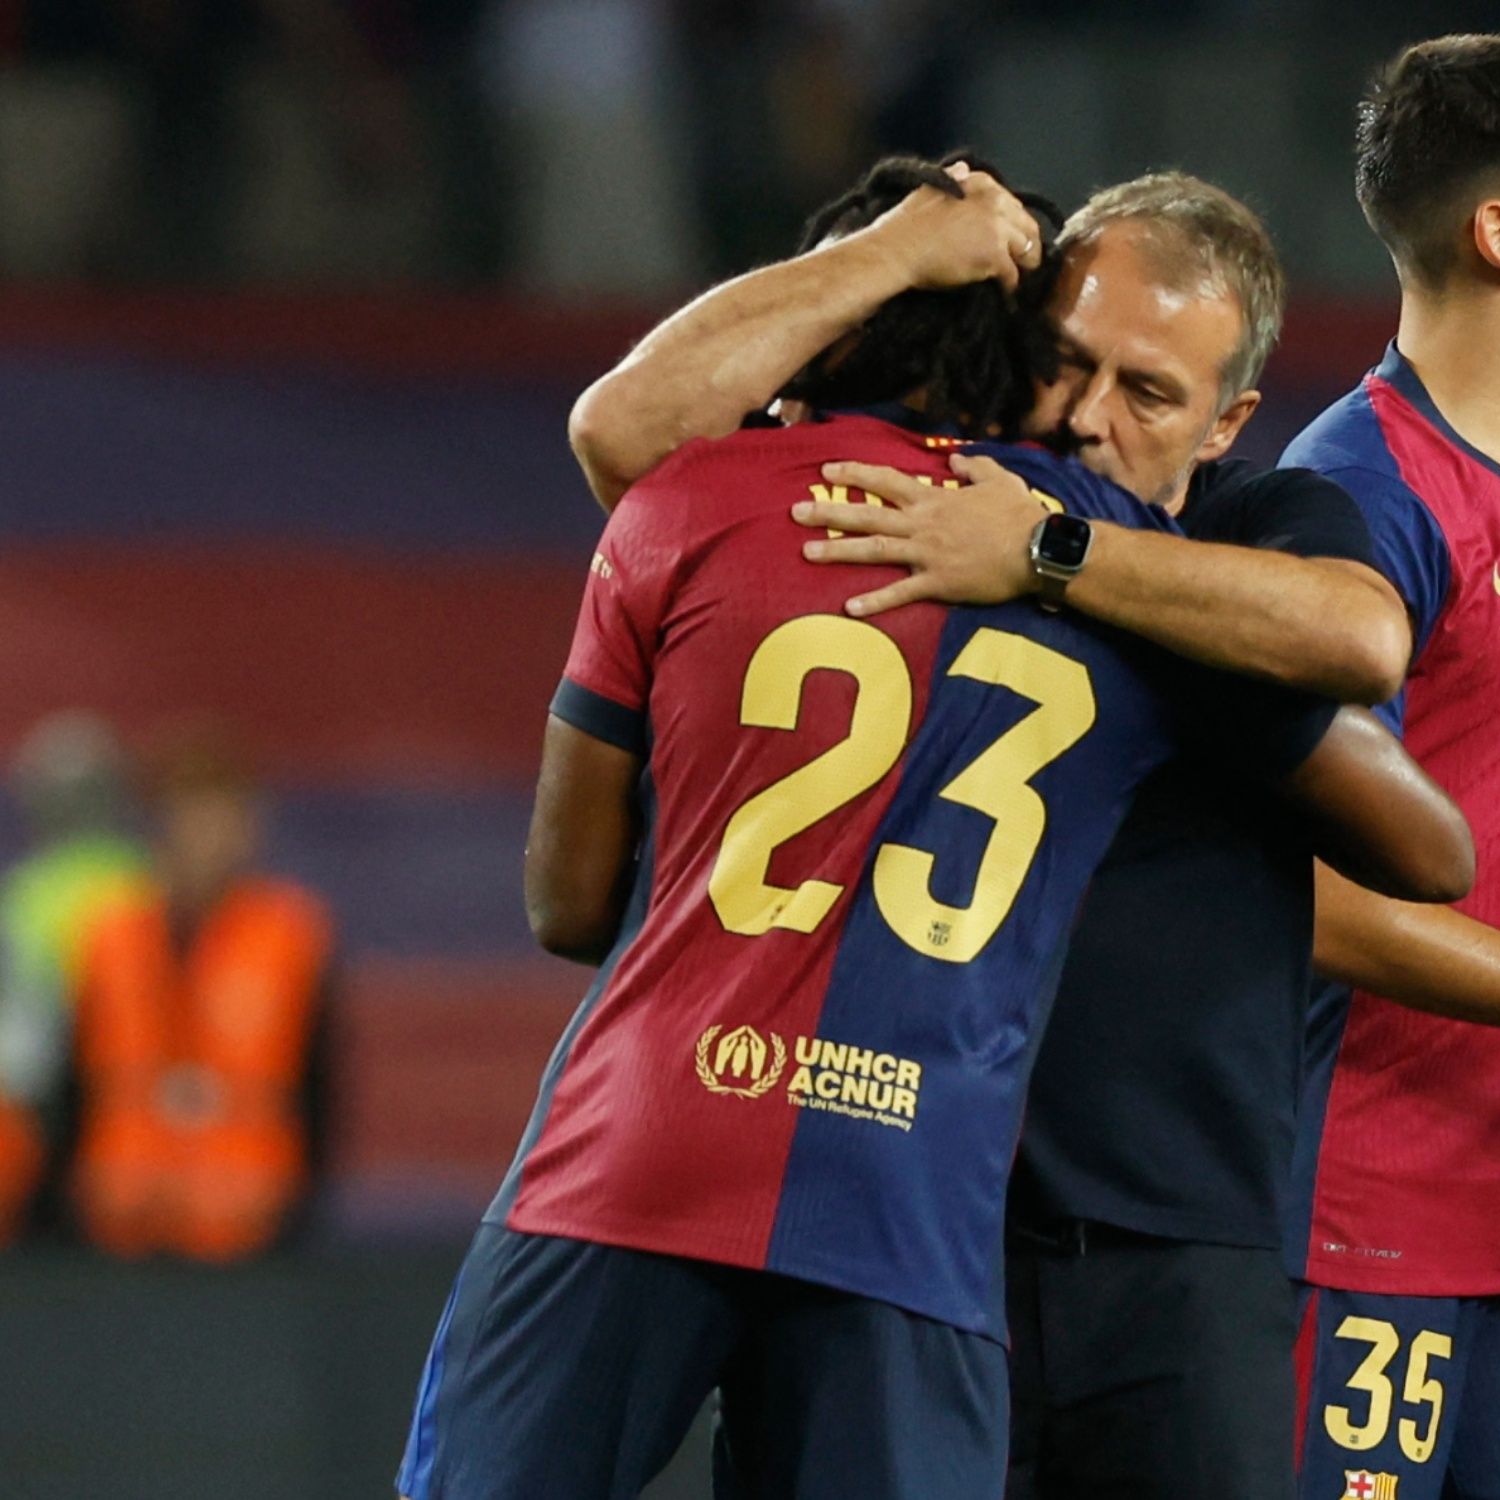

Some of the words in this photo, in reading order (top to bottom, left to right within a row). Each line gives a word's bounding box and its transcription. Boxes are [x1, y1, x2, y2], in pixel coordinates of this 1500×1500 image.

[708, 614, 1097, 963] 23
[795, 1036, 922, 1090] UNHCR
[787, 1066, 917, 1118] ACNUR
[787, 1094, 807, 1108] The
[809, 1098, 827, 1110] UN
[828, 1101, 874, 1119] Refugee
[875, 1111, 912, 1132] Agency
[1323, 1315, 1452, 1464] 35
